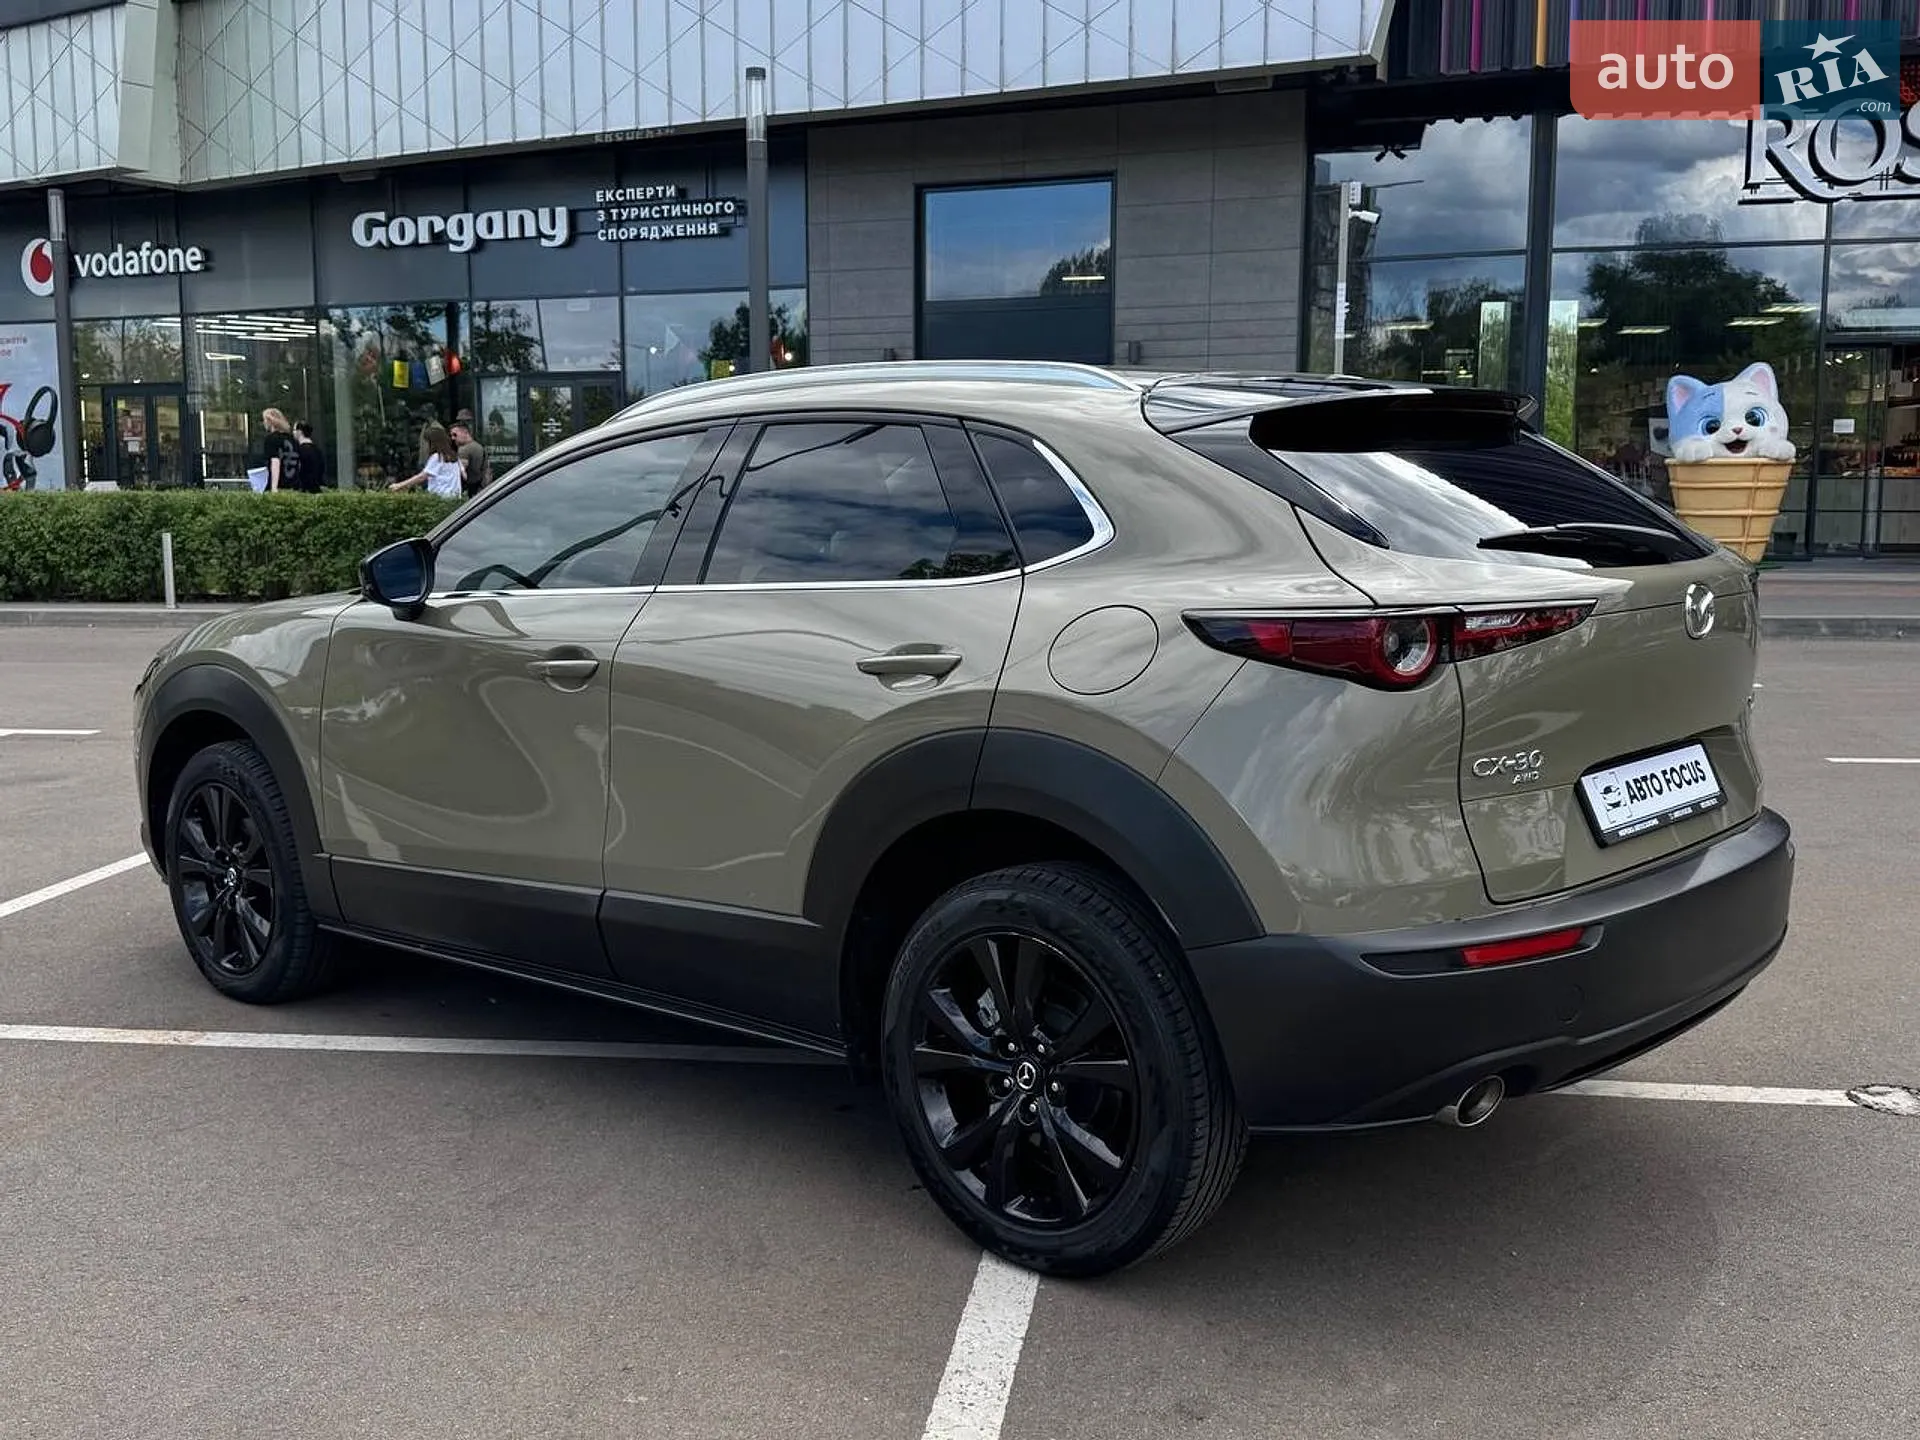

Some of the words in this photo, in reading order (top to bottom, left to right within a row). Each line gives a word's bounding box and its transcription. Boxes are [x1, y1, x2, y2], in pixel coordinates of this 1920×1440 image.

[595, 184, 676, 202] ЕКСПЕРТИ
[609, 201, 736, 222] ТУРИСТИЧНОГО
[351, 206, 568, 253] Gorgany
[597, 222, 719, 241] СПОРЯДЖЕННЯ
[74, 241, 203, 278] vodafone
[1473, 749, 1543, 777] CX-30
[1624, 772, 1664, 805] АВТО
[1660, 759, 1707, 792] FOCUS
